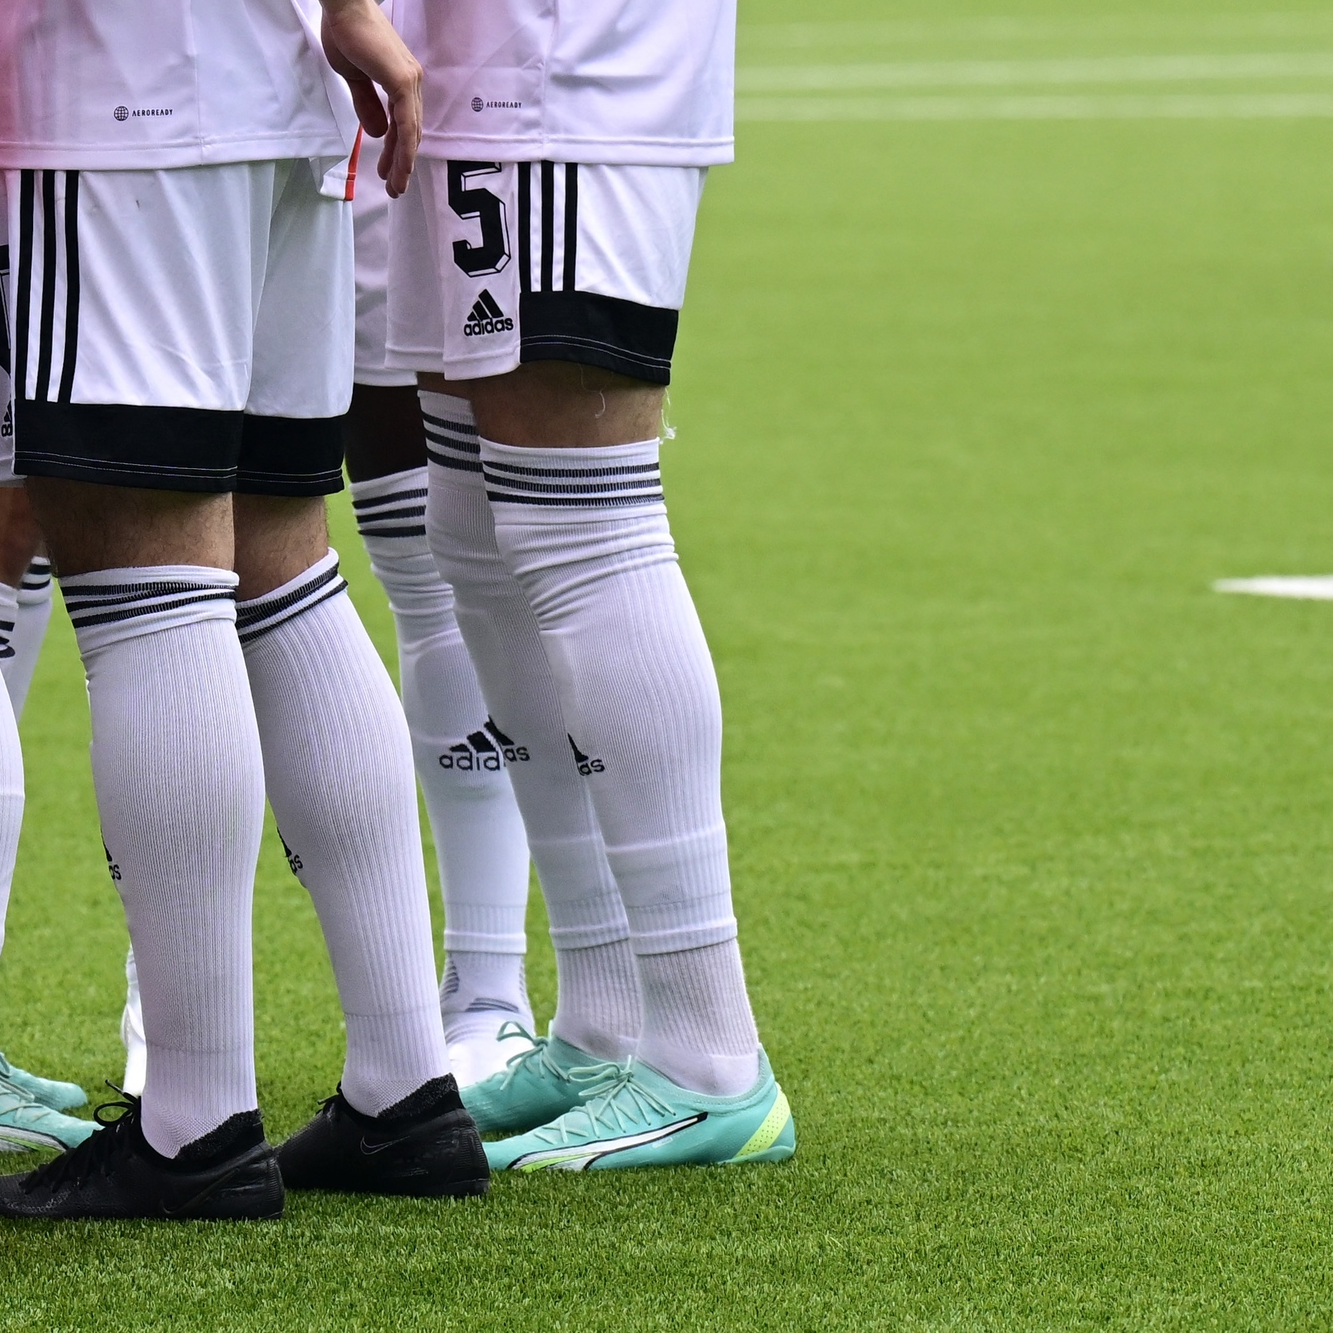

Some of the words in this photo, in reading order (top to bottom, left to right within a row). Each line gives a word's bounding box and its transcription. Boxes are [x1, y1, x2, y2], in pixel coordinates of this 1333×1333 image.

[485, 101, 522, 109] AEROREADY
[131, 108, 173, 117] AEROREADY
[447, 159, 512, 278] 5
[463, 317, 514, 337] adidas
